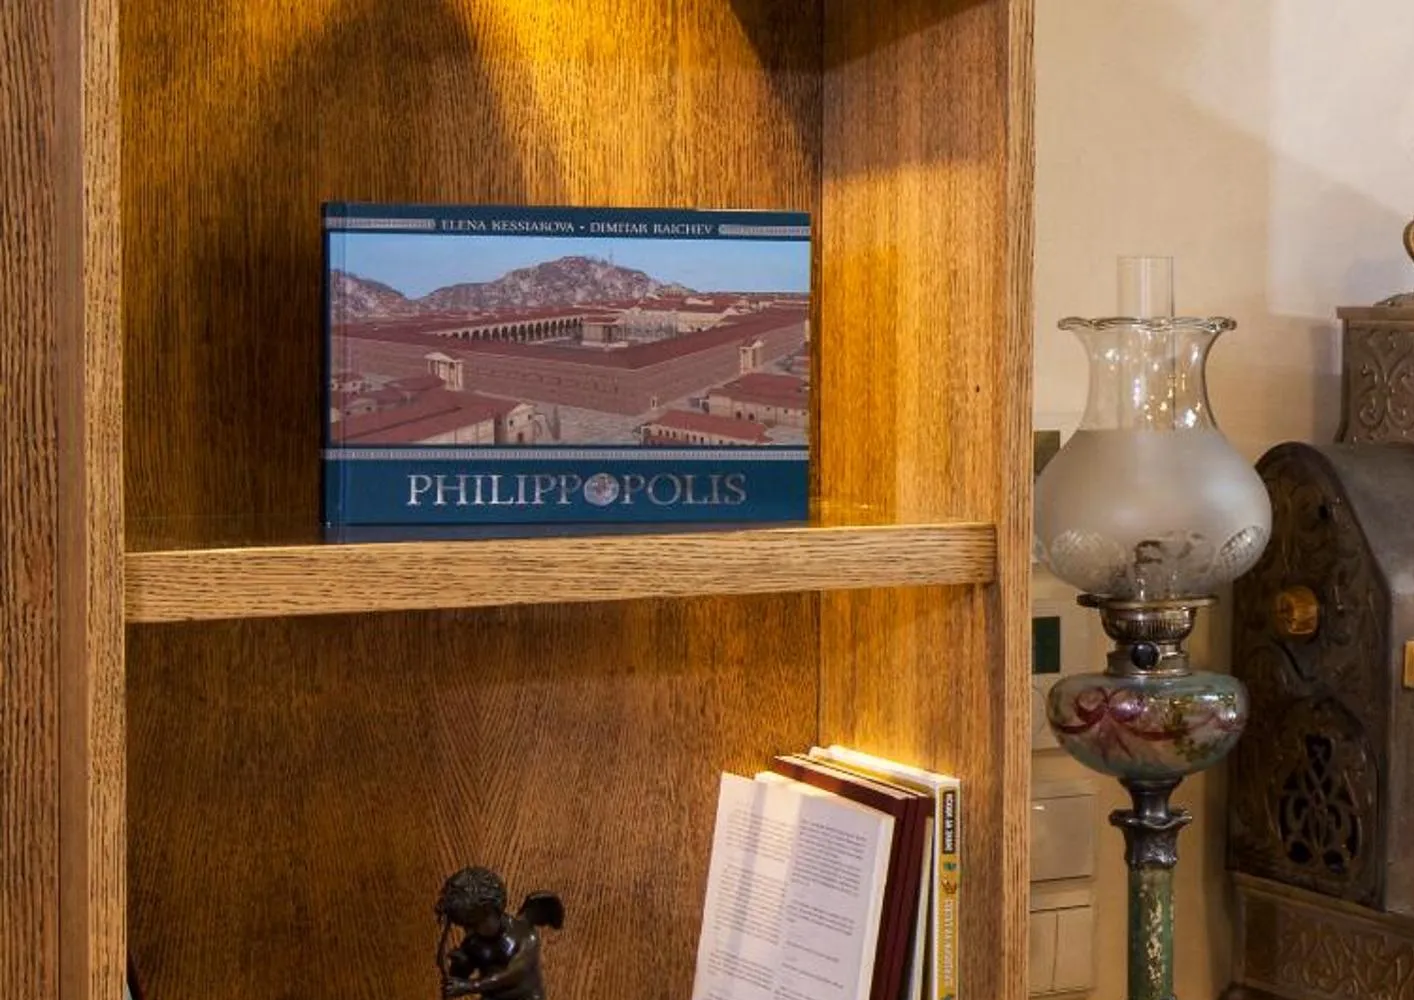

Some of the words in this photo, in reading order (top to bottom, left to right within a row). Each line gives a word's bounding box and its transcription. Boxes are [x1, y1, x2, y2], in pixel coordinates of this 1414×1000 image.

[441, 219, 486, 231] ELENA
[589, 222, 649, 234] DIMITAR
[407, 472, 747, 507] PHILIPPOPOLIS
